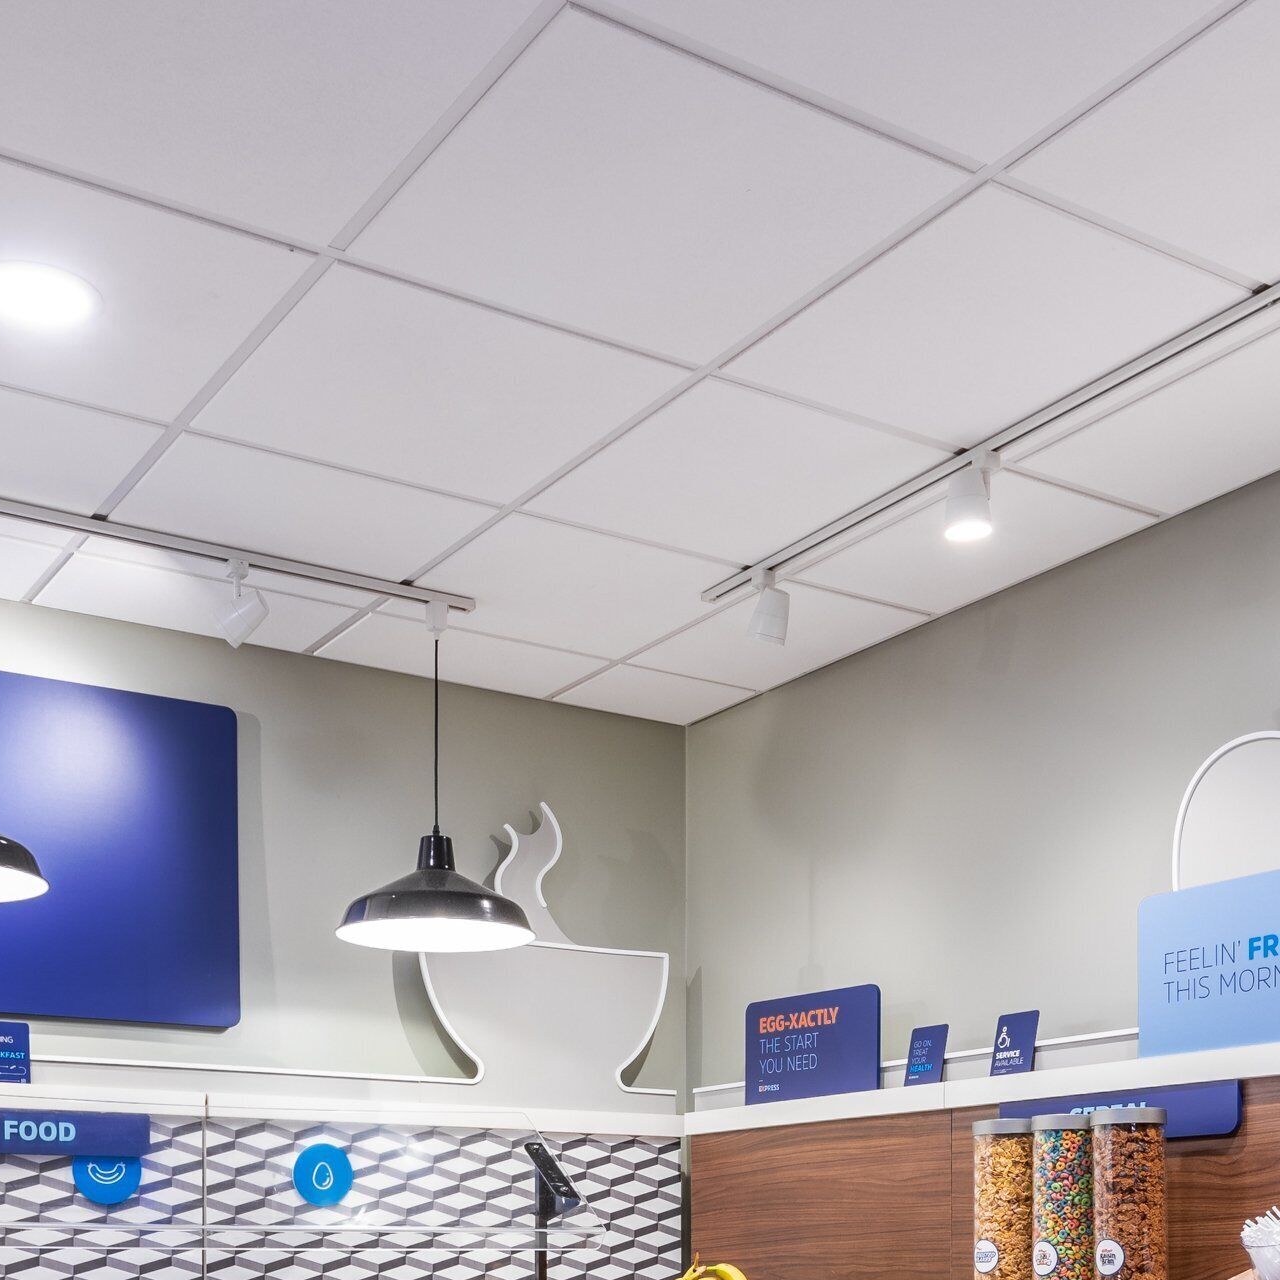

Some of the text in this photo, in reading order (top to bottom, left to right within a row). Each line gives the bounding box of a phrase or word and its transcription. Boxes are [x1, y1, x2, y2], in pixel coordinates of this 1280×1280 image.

[1164, 939, 1241, 975] FEELIN'
[1163, 975, 1211, 1003] THIS
[759, 1006, 839, 1034] EGG-XACTLY
[760, 1032, 819, 1054] THE START
[760, 1053, 818, 1075] YOU NEED
[994, 1056, 1024, 1067] AVAILABLE
[996, 1050, 1020, 1059] SERVICE
[4, 1120, 77, 1142] FOOD
